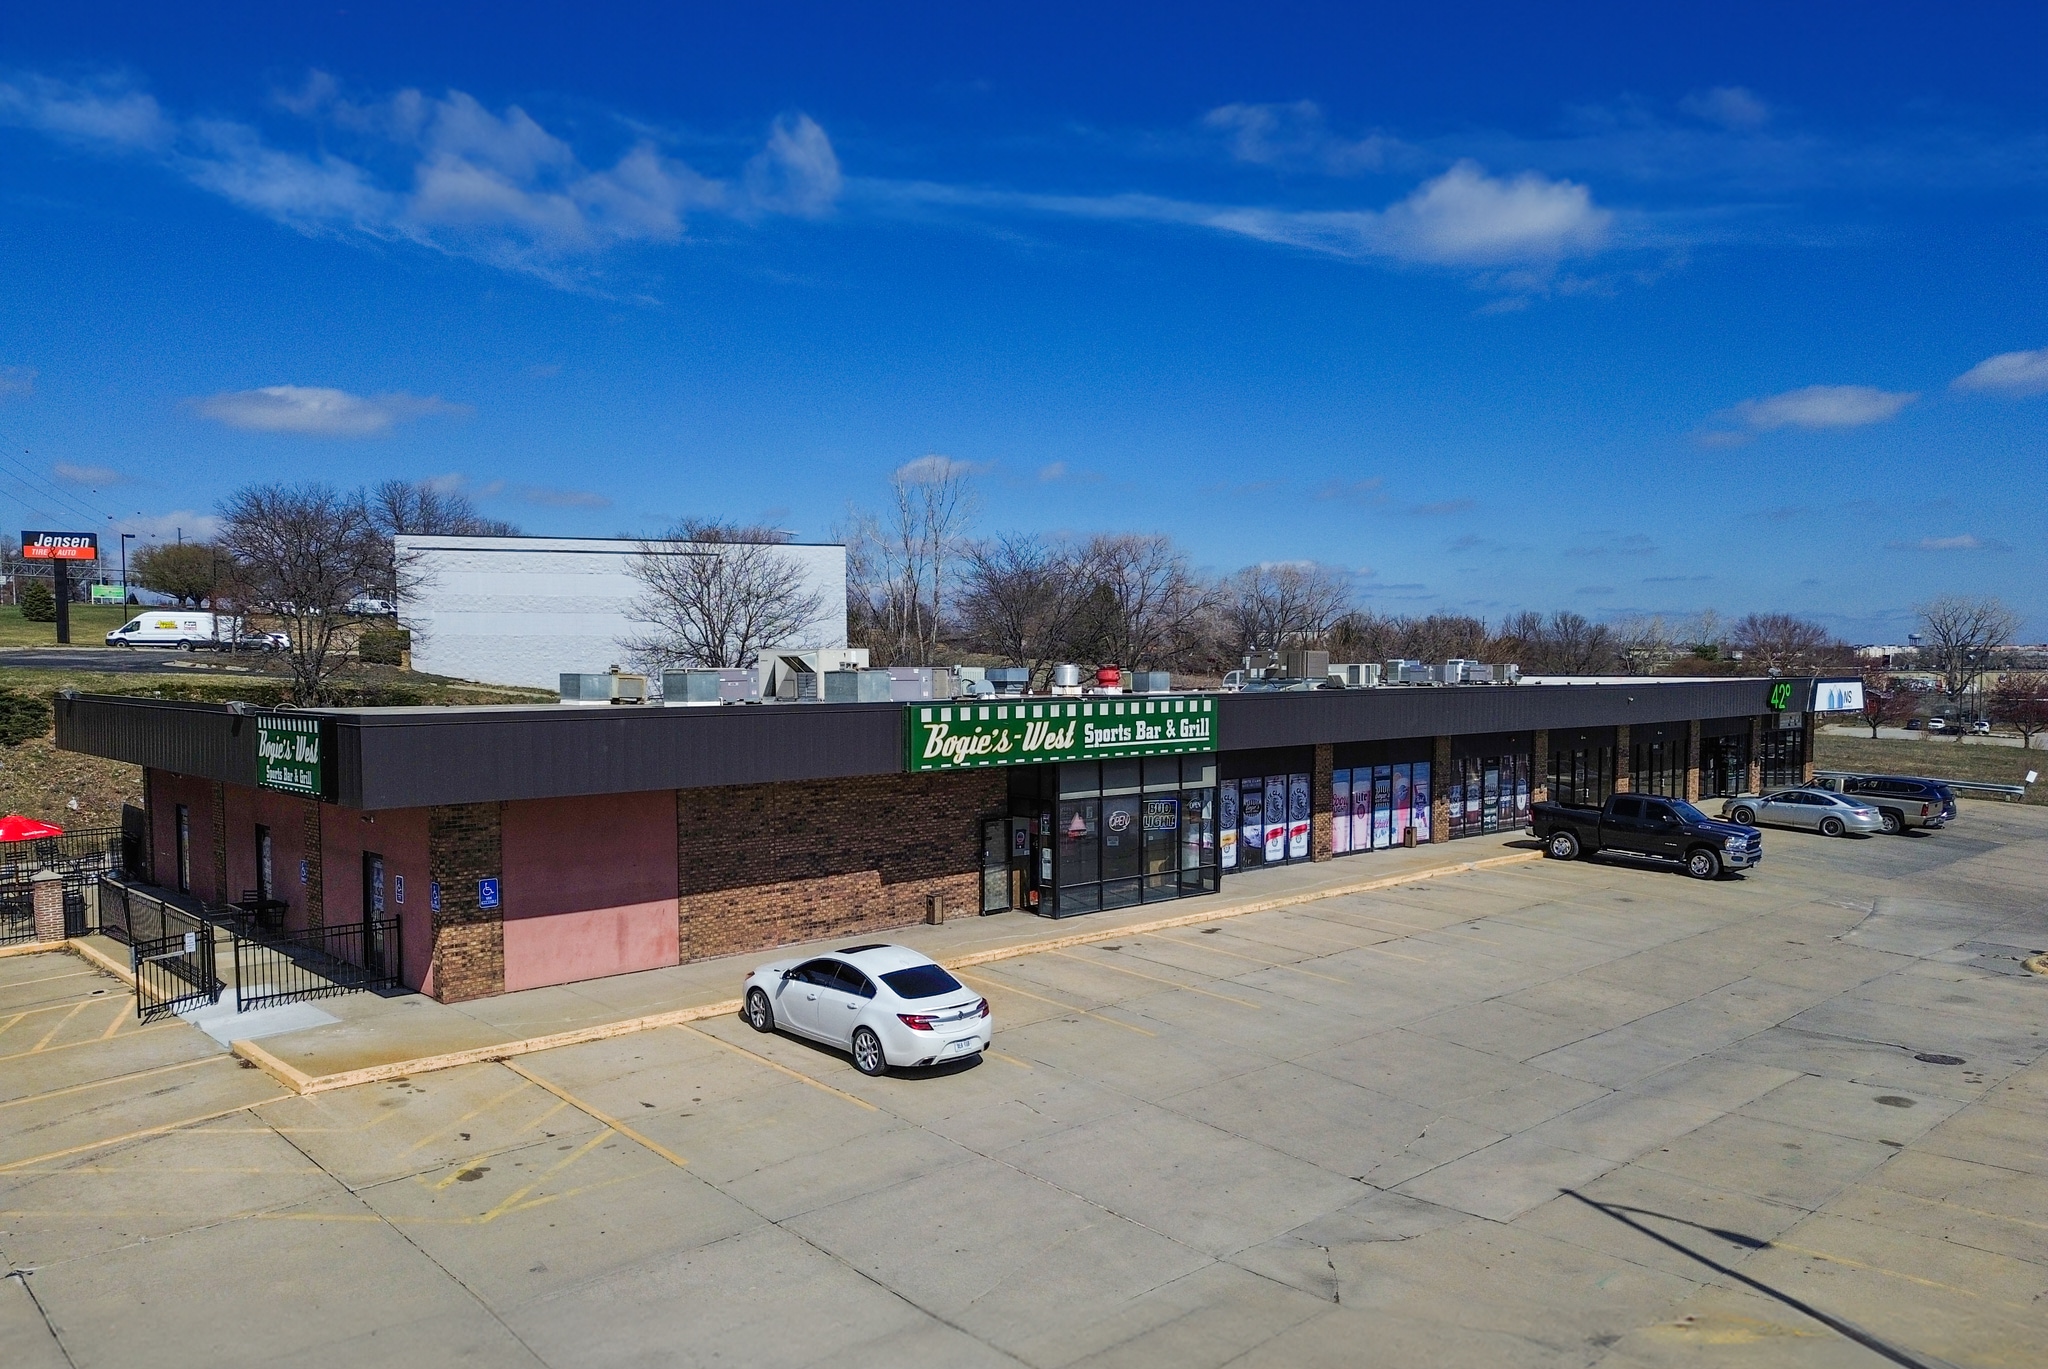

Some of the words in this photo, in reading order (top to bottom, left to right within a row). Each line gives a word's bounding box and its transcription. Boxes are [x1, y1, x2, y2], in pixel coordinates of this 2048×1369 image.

[34, 533, 90, 548] Jensen
[31, 548, 48, 556] TIRE
[48, 547, 57, 558] &
[57, 549, 77, 557] AUTO
[1084, 723, 1132, 748] Sports
[1135, 720, 1162, 741] Bar
[1166, 719, 1176, 739] &
[1180, 717, 1210, 738] Grill
[266, 764, 283, 781] Sports
[283, 767, 294, 782] Bar
[299, 769, 313, 785] Grill
[1355, 792, 1368, 804] Lite
[1148, 802, 1172, 815] BUD
[1143, 814, 1175, 828] LIGHT
